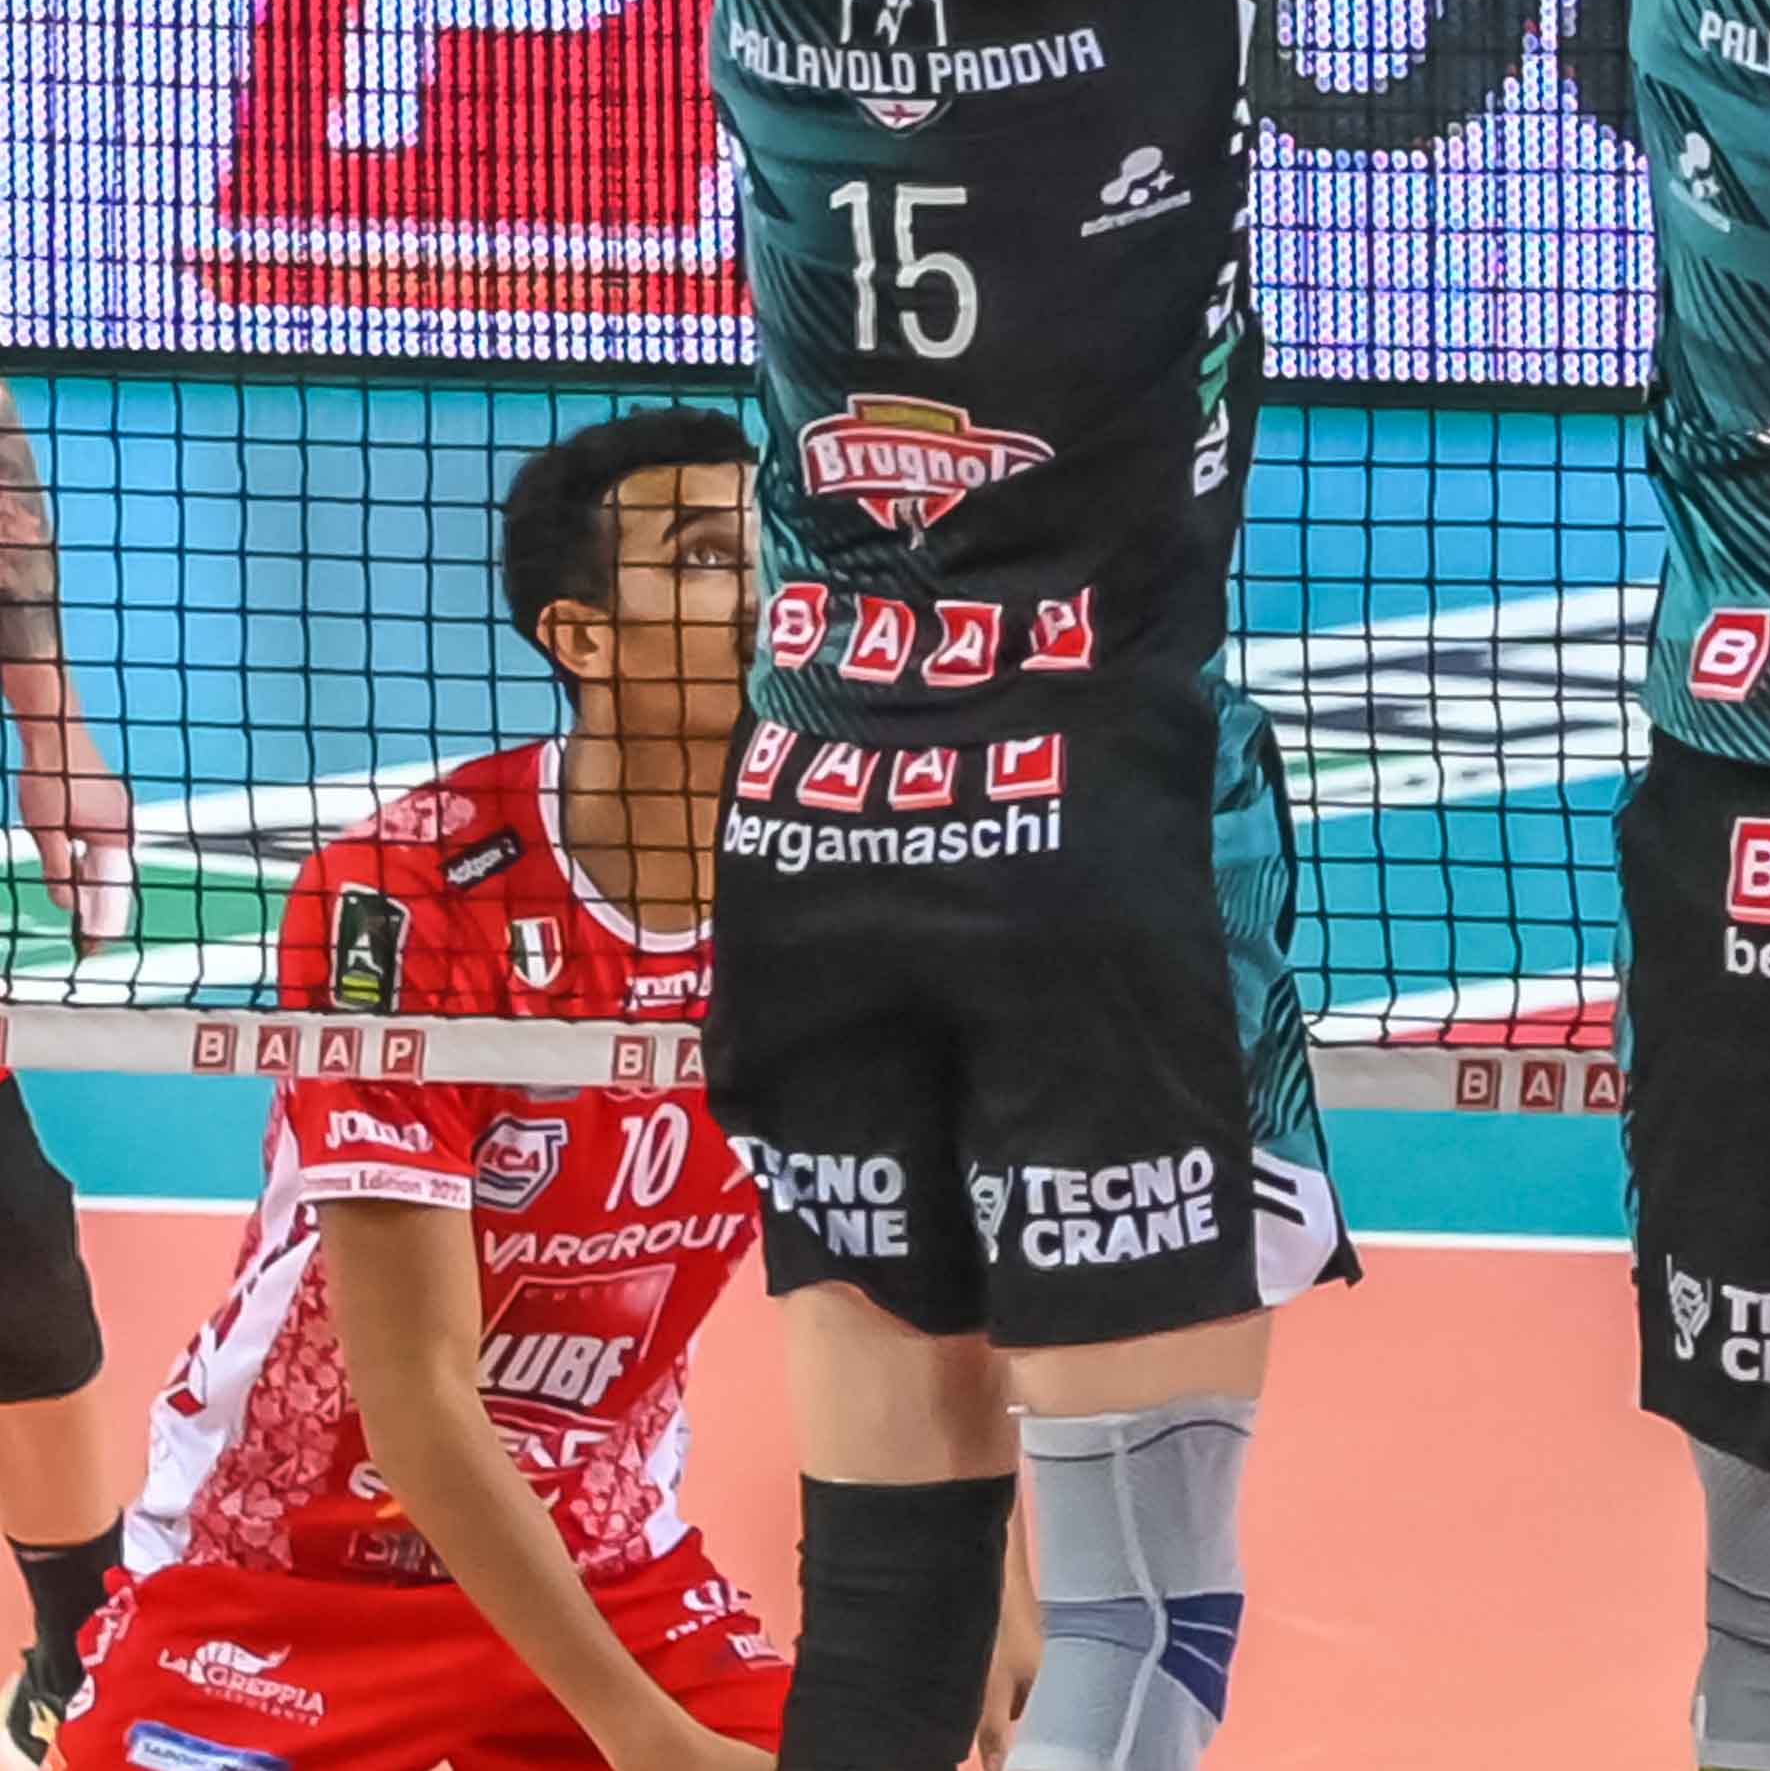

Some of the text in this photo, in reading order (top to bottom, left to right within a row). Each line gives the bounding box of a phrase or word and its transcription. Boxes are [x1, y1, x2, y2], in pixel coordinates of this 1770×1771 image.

[729, 24, 1105, 94] PALLAVOLO PADOVA
[830, 181, 978, 358] 15
[771, 591, 1084, 676] BAAP
[743, 721, 1054, 798] BAAP
[724, 801, 1061, 872] bergamaschi
[198, 1032, 418, 1072] BAAP
[614, 1040, 704, 1081] BA
[1460, 1062, 1624, 1108] BAA
[605, 1102, 690, 1212] 10
[1022, 1146, 1215, 1215] TECNO
[1022, 1200, 1219, 1269] CRANE
